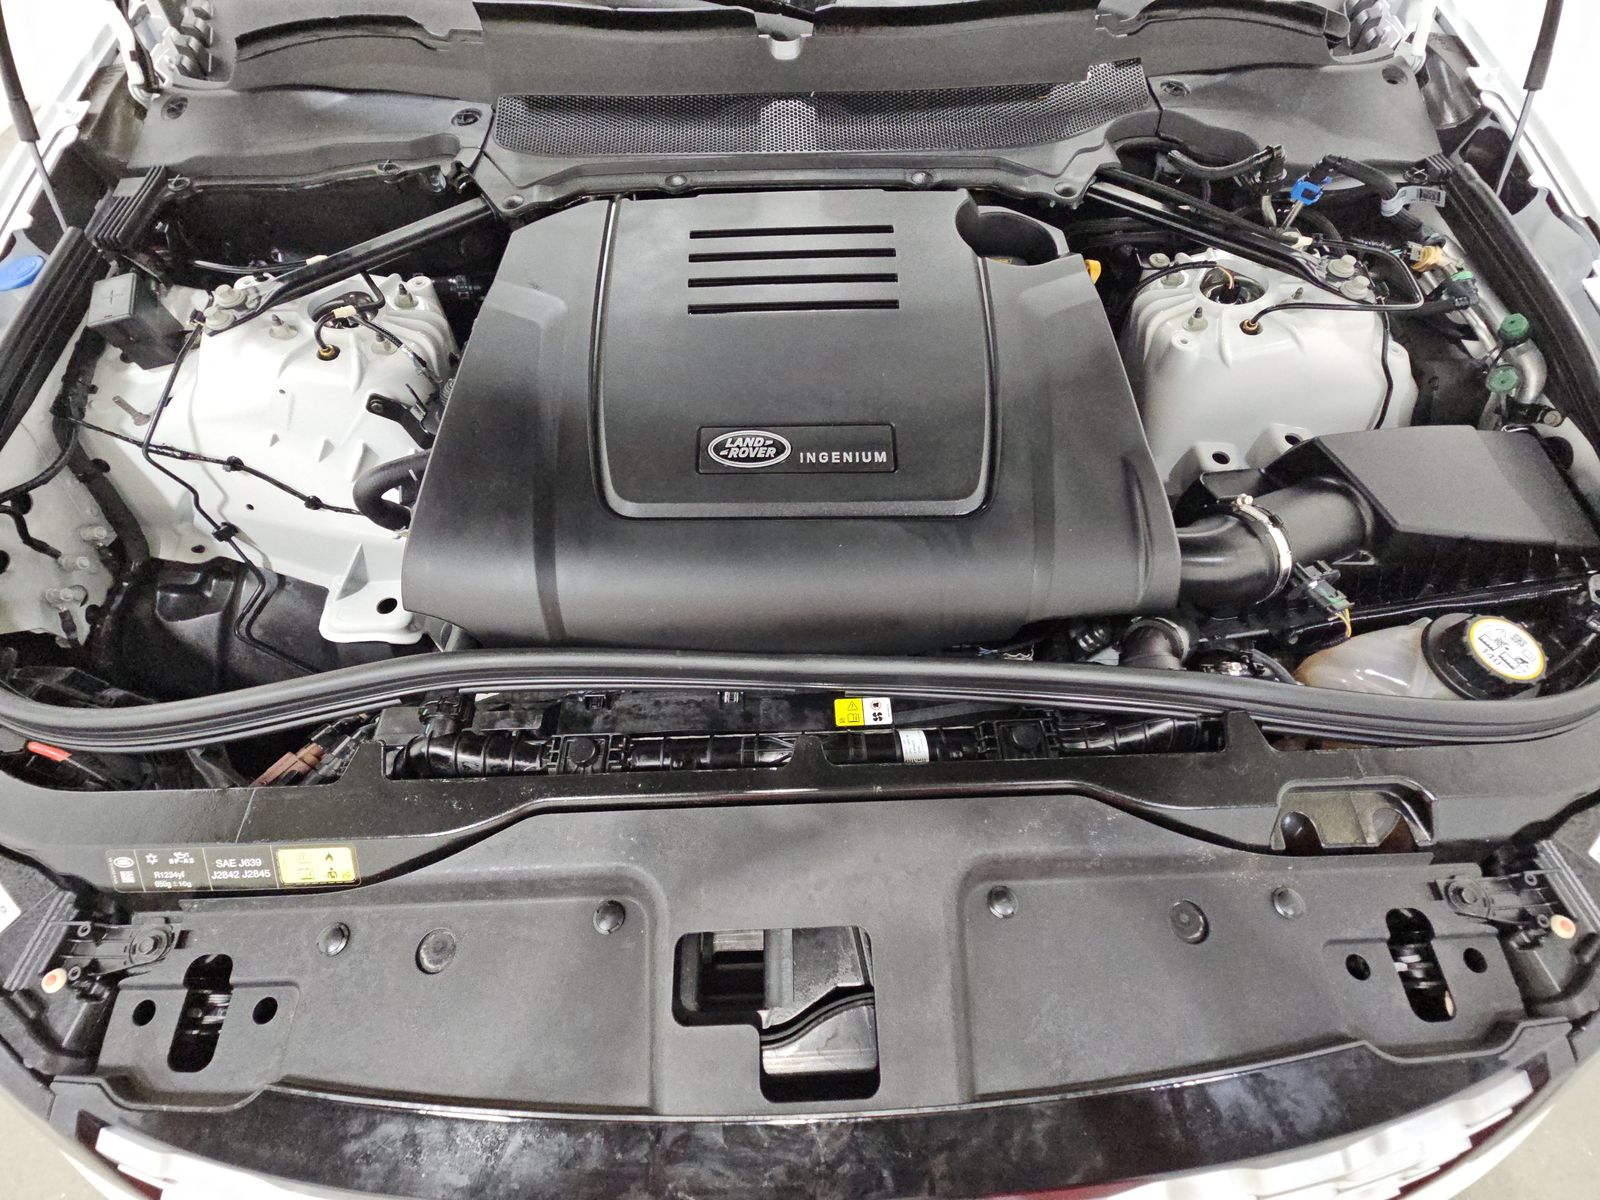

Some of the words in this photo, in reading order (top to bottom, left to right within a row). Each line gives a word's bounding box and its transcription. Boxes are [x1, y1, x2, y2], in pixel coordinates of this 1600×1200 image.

[799, 451, 887, 464] INGENIUM
[215, 858, 237, 868] SAE
[238, 858, 262, 867] J639
[153, 870, 185, 879] R1234yf
[211, 870, 240, 880] J2842
[241, 869, 271, 879] J2845
